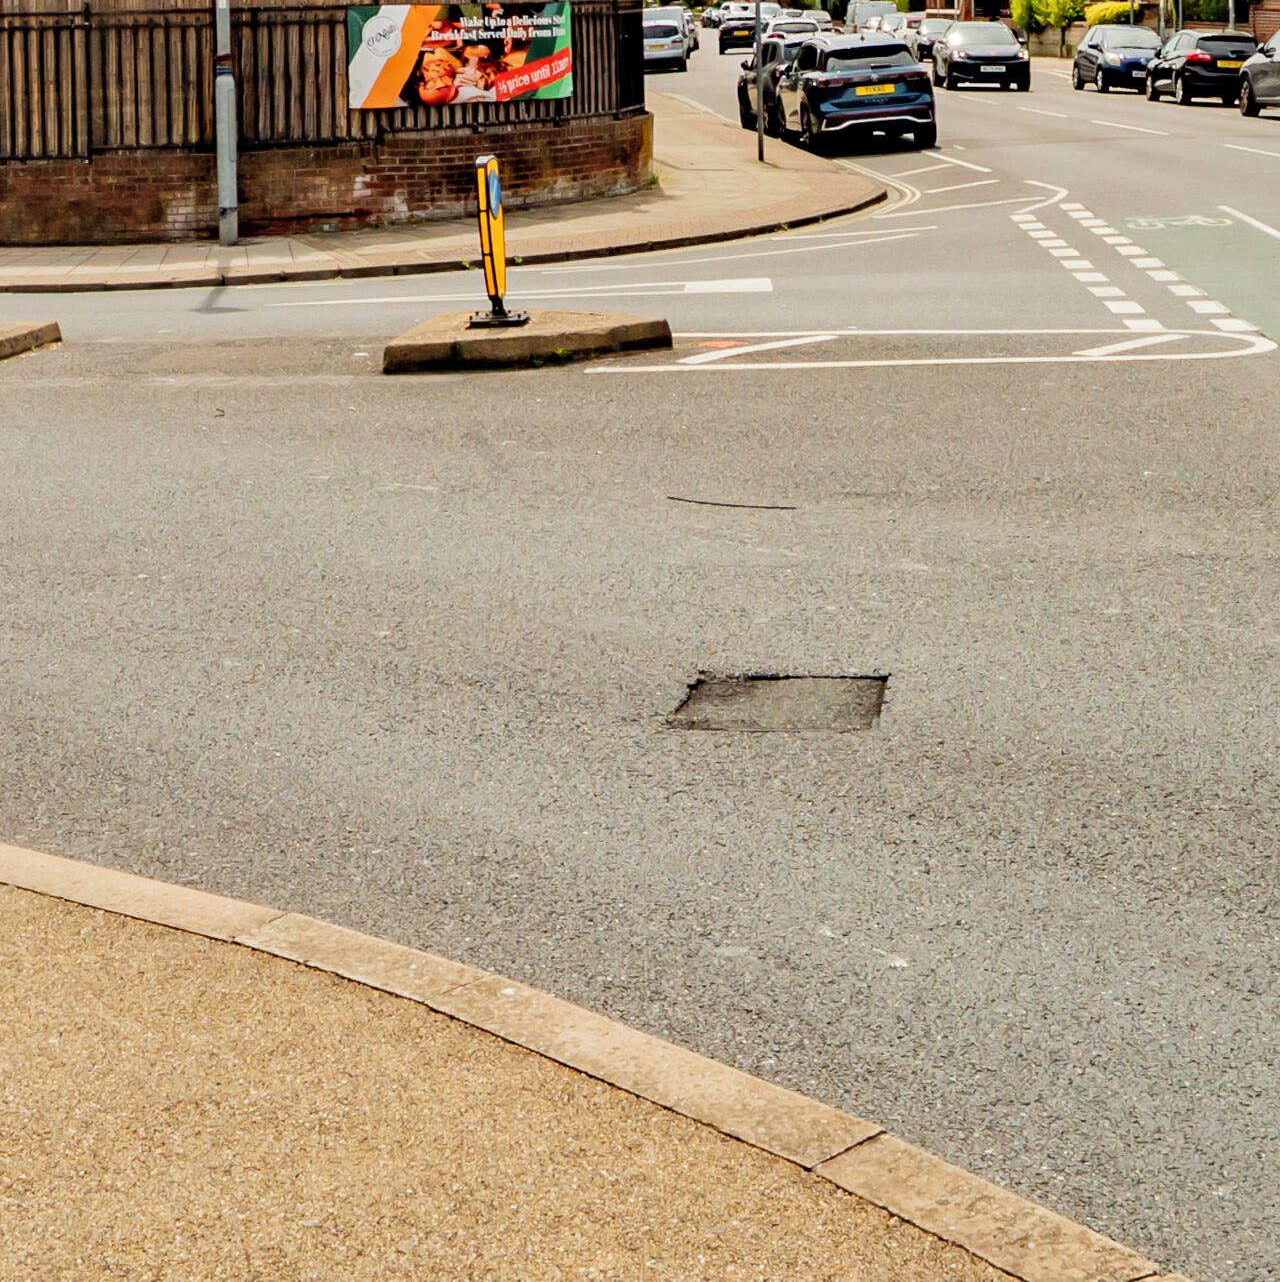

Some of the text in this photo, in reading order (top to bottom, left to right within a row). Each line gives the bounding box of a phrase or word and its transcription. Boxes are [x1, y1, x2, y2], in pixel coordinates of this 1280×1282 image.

[512, 15, 552, 26] Delicious
[431, 29, 478, 41] Breakfast
[478, 29, 506, 39] Served
[528, 27, 552, 38] from
[507, 74, 530, 93] price
[531, 64, 551, 83] until
